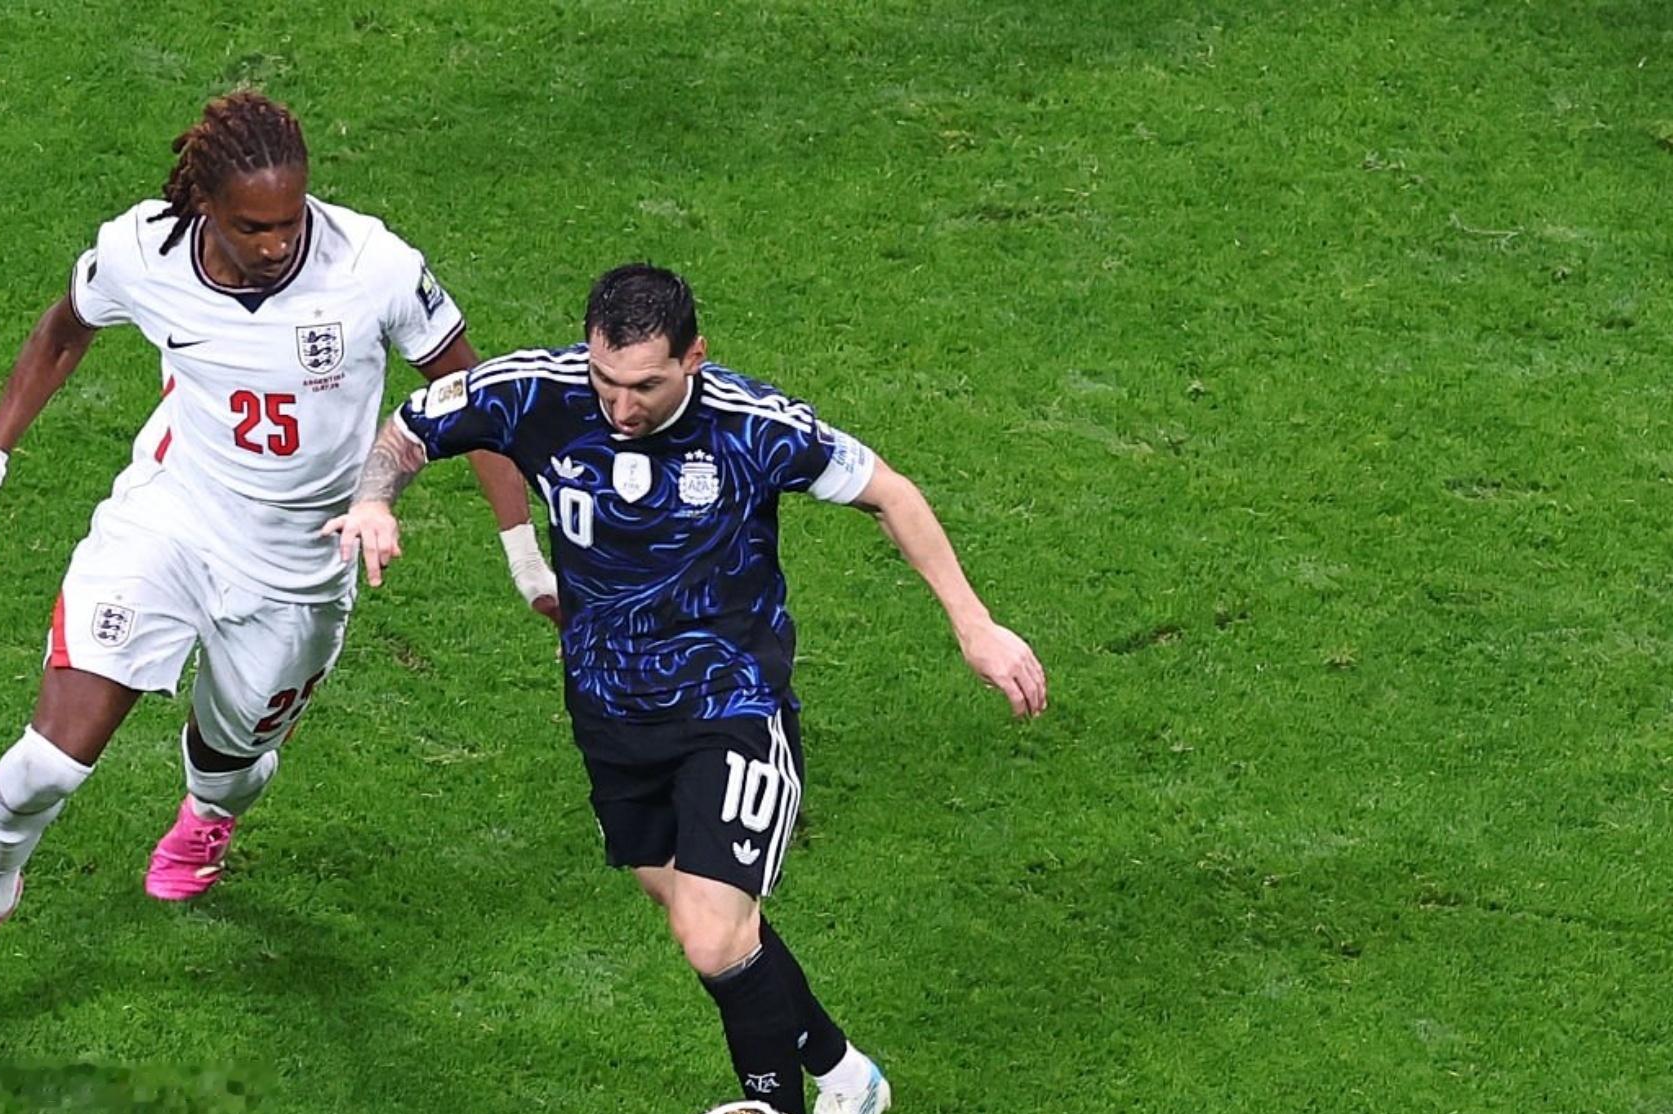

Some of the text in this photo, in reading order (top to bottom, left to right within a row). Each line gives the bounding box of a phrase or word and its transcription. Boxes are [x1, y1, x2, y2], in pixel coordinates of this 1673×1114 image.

[230, 390, 300, 457] 25
[536, 473, 595, 549] 10
[720, 750, 780, 834] 10
